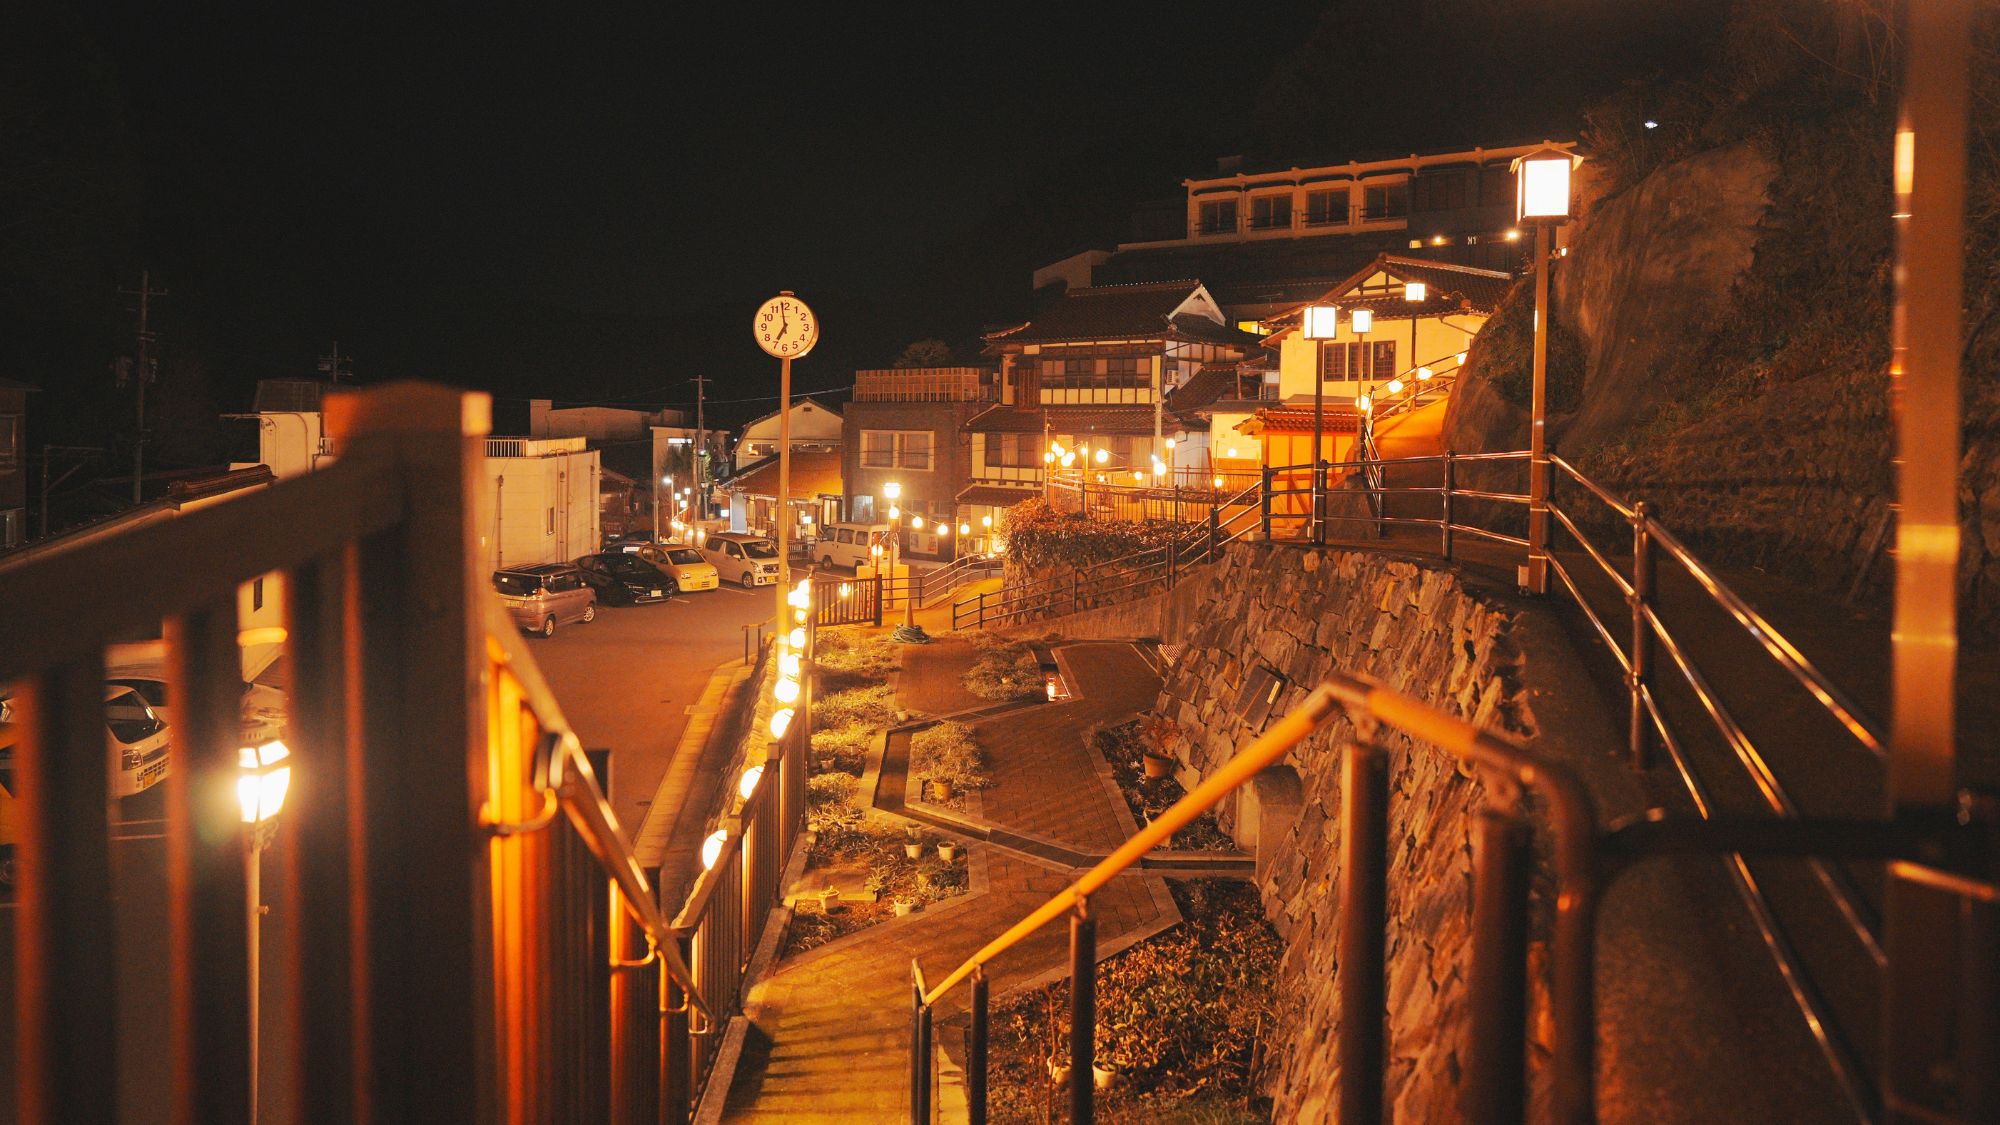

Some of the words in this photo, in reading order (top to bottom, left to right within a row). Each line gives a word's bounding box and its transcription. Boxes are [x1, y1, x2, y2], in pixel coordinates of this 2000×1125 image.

[800, 313, 806, 321] 2
[761, 323, 767, 331] 9
[803, 323, 809, 331] 3
[800, 334, 805, 342] 4
[773, 341, 779, 349] 7
[782, 344, 788, 352] 6
[793, 341, 798, 349] 5
